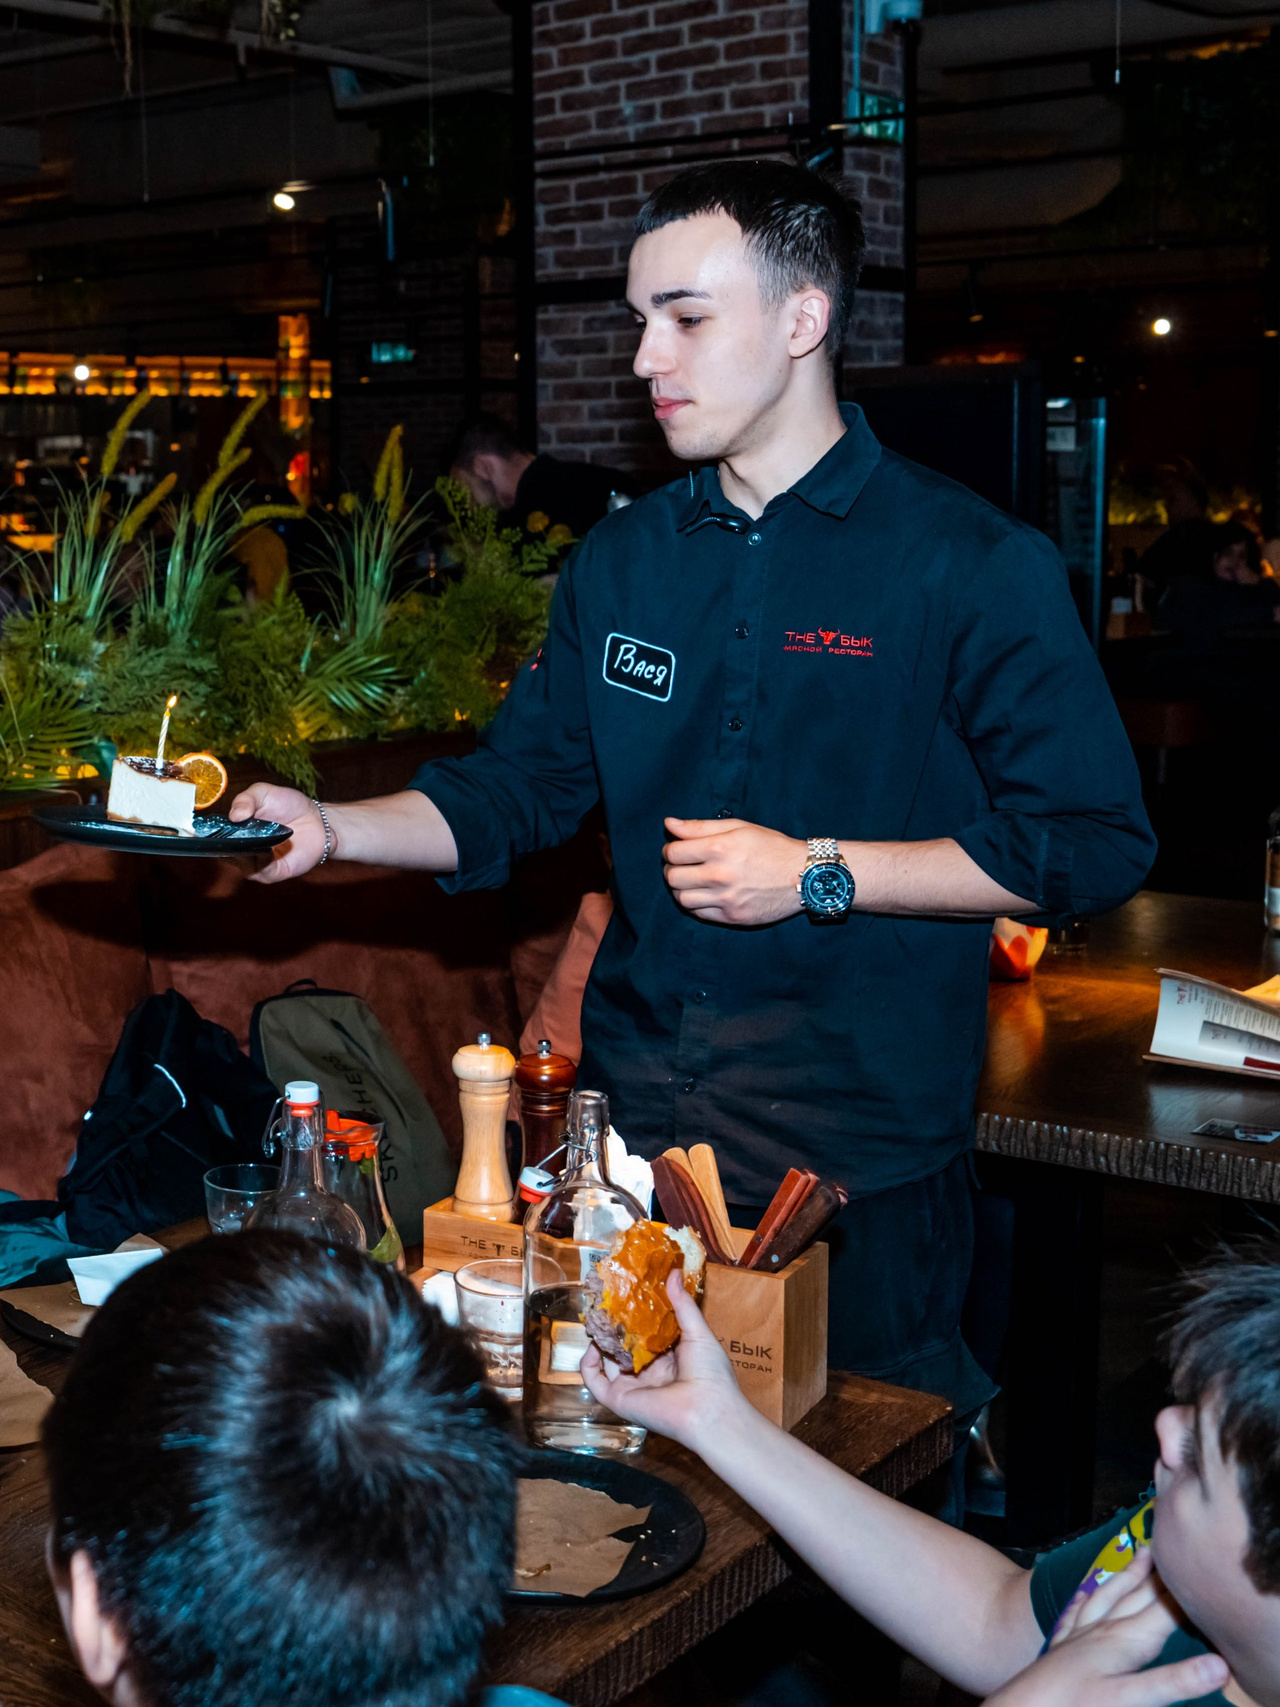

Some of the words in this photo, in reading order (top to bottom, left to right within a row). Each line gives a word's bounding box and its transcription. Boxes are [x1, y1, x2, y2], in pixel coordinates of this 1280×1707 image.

[784, 631, 817, 644] THE
[840, 634, 873, 648] БЫК
[828, 647, 874, 658] РЕСТОРАН
[460, 1235, 487, 1250] THE
[730, 1340, 772, 1360] БЫК
[729, 1359, 773, 1373] ТОРАН
